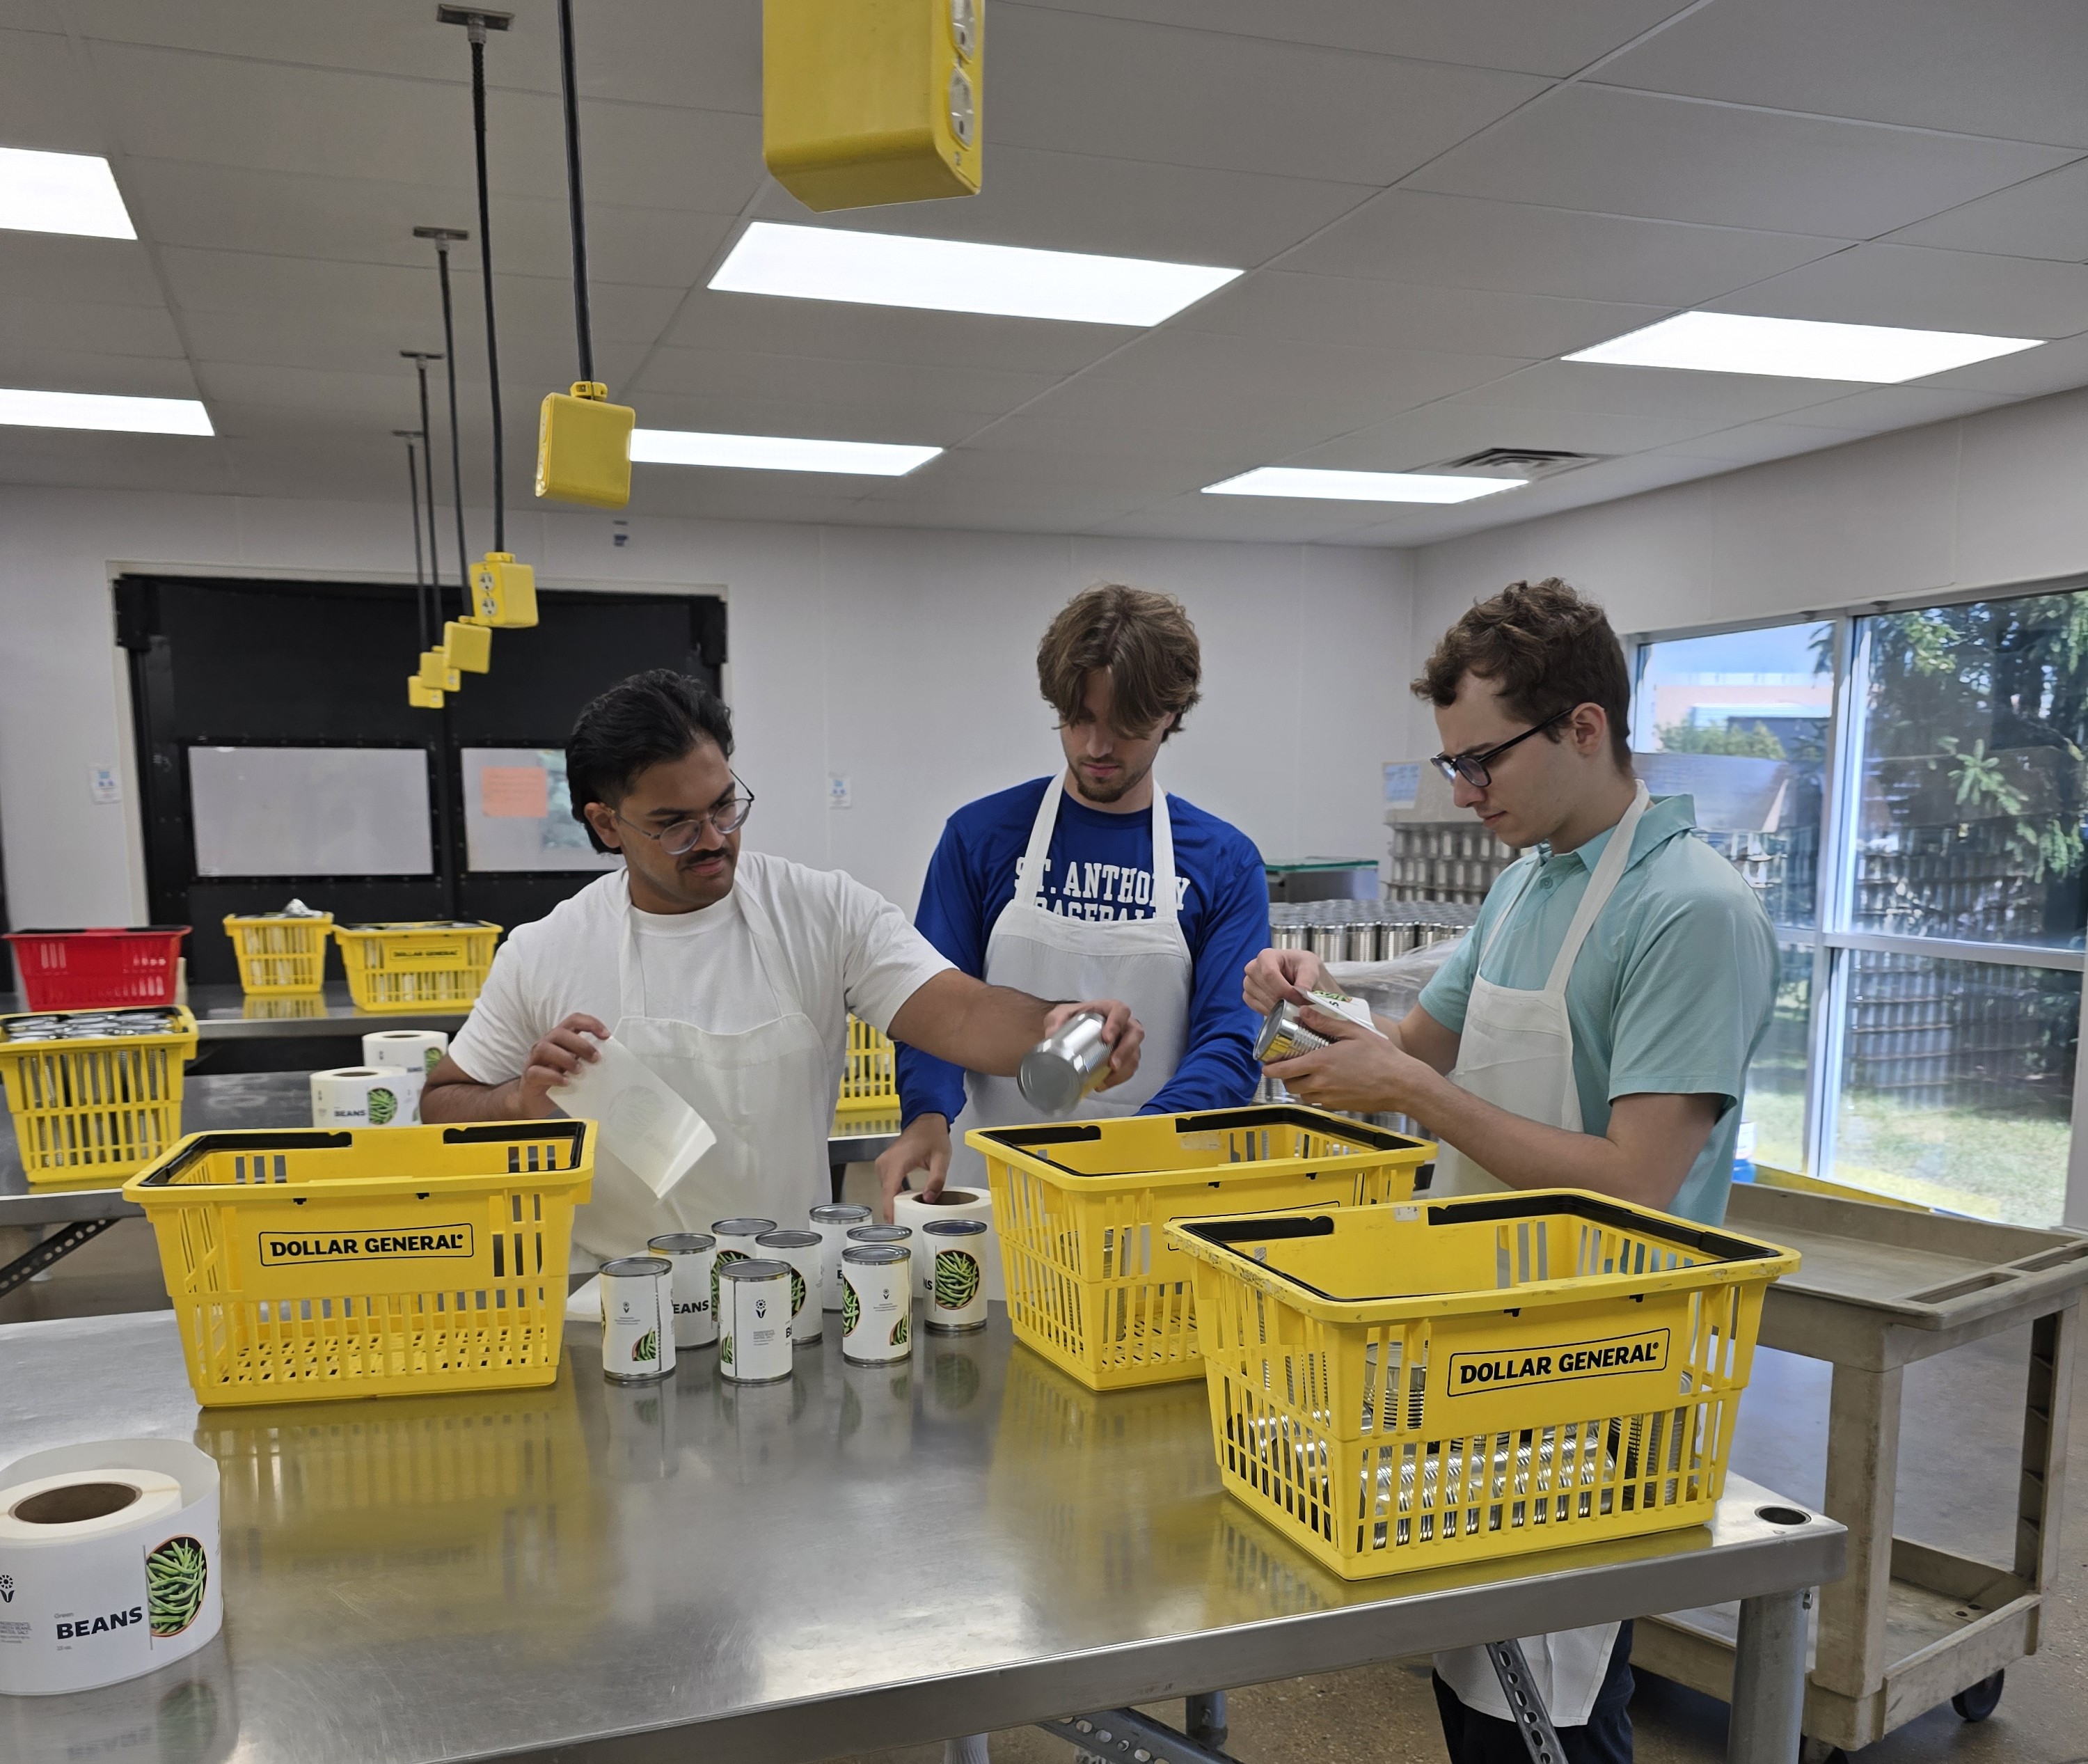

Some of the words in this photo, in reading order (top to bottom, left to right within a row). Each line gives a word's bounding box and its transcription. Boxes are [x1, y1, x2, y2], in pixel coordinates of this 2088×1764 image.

[1063, 862, 1191, 911] ANTHOY
[270, 1238, 359, 1257] DOLLAR
[673, 1300, 709, 1314] EANS
[1460, 1356, 1551, 1384] DOLLAR
[56, 1606, 143, 1639] BEANS
